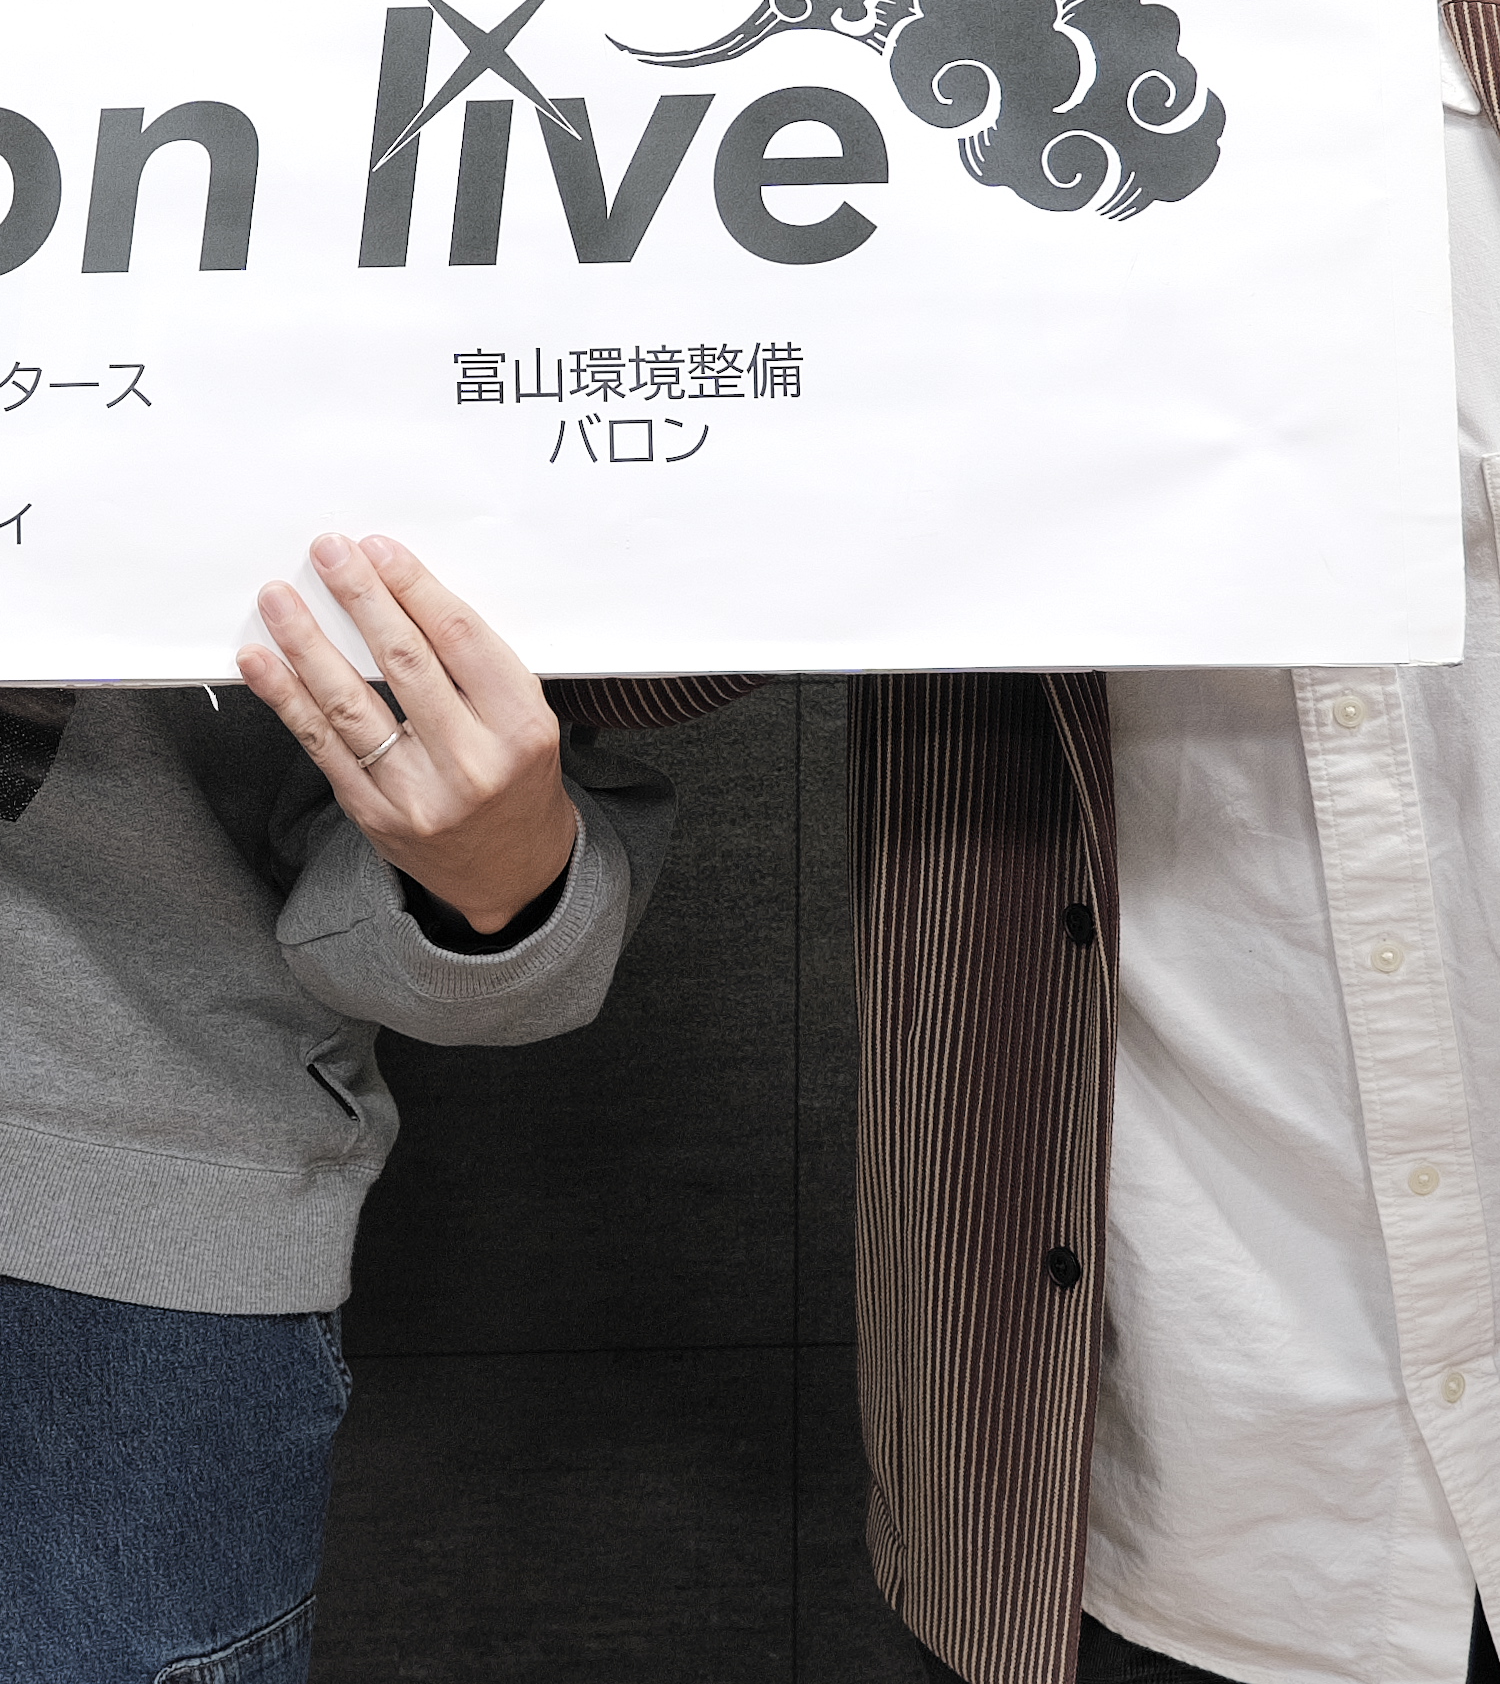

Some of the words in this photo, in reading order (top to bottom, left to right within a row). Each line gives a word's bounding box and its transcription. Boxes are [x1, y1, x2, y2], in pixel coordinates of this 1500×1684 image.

[357, 6, 890, 267] live
[453, 341, 804, 405] 富山環境整備
[549, 412, 710, 464] バロン
